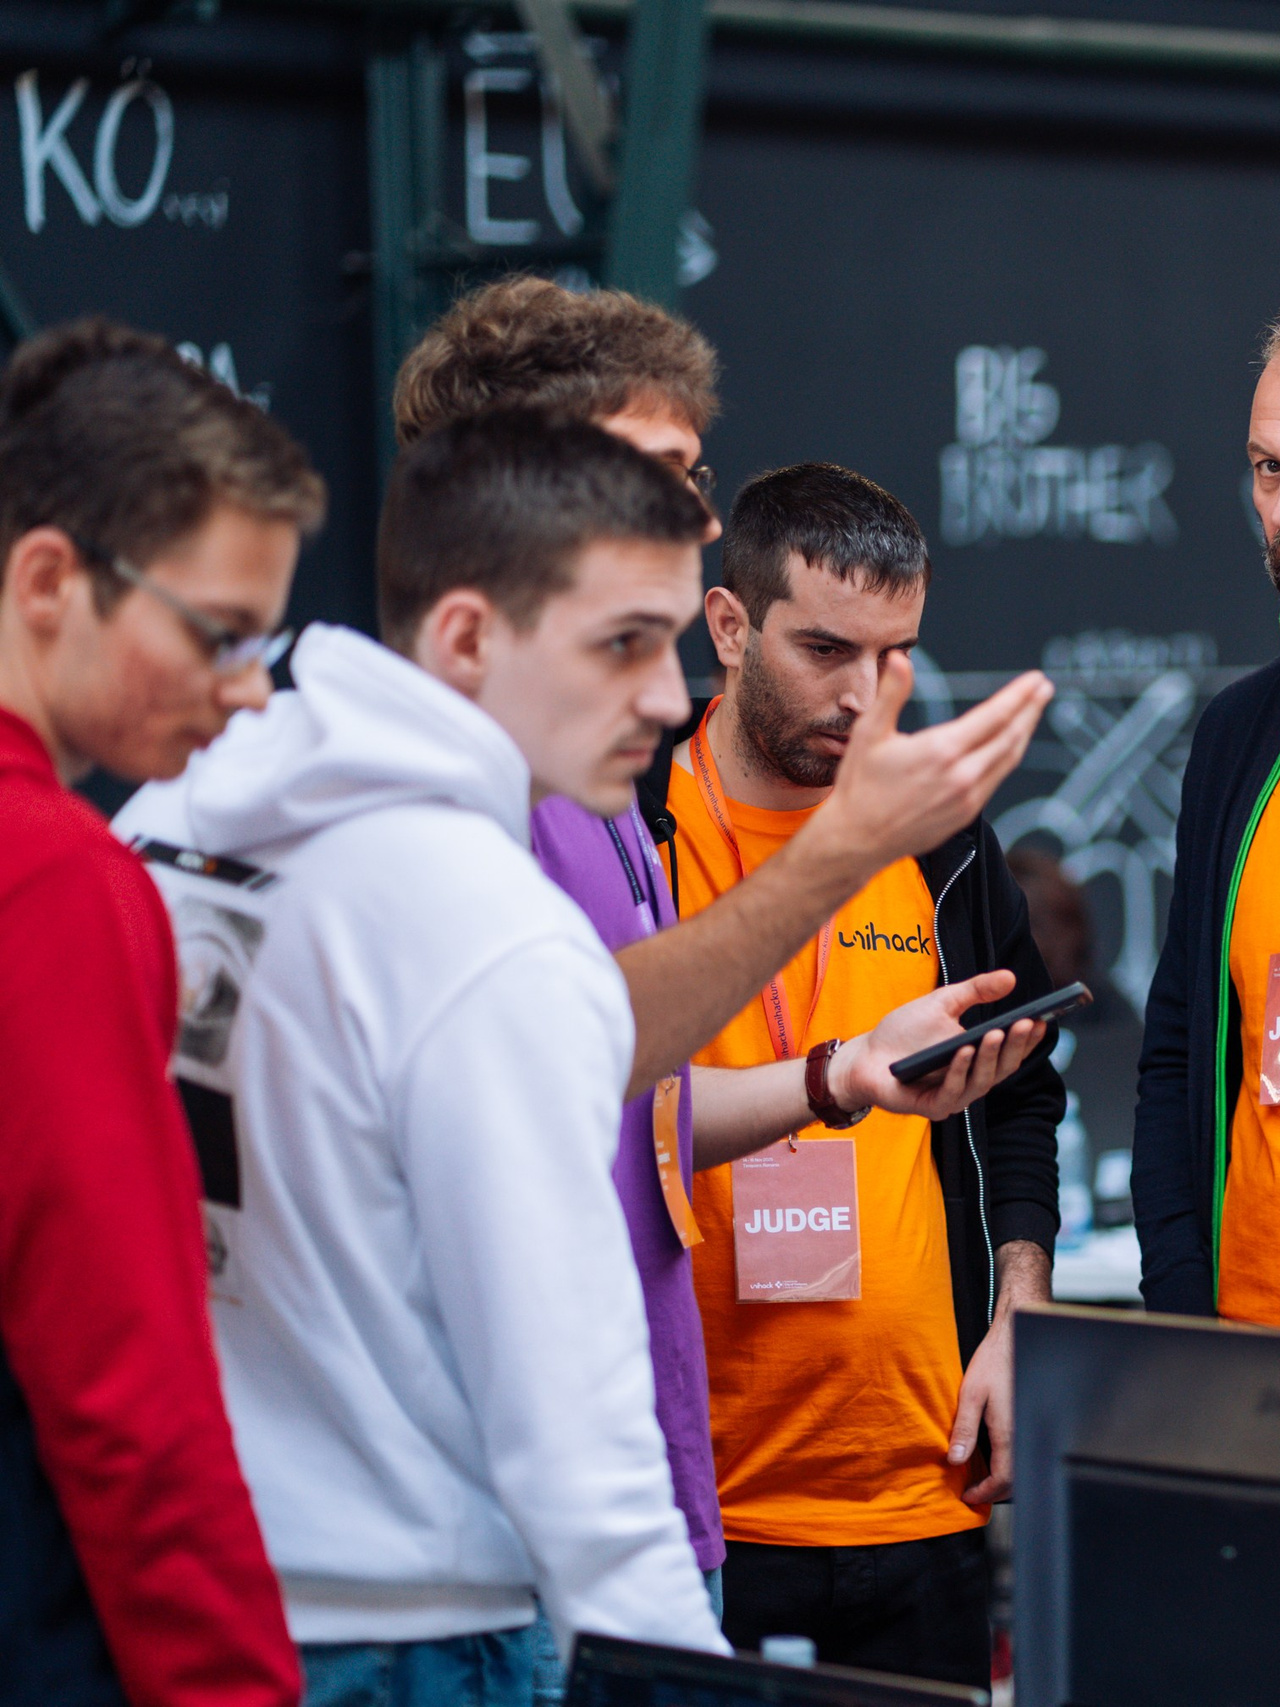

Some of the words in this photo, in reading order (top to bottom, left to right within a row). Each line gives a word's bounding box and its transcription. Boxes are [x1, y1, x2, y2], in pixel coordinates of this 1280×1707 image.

[955, 344, 1060, 446] BIG
[838, 921, 931, 956] unihack
[745, 1206, 851, 1234] JUDGE
